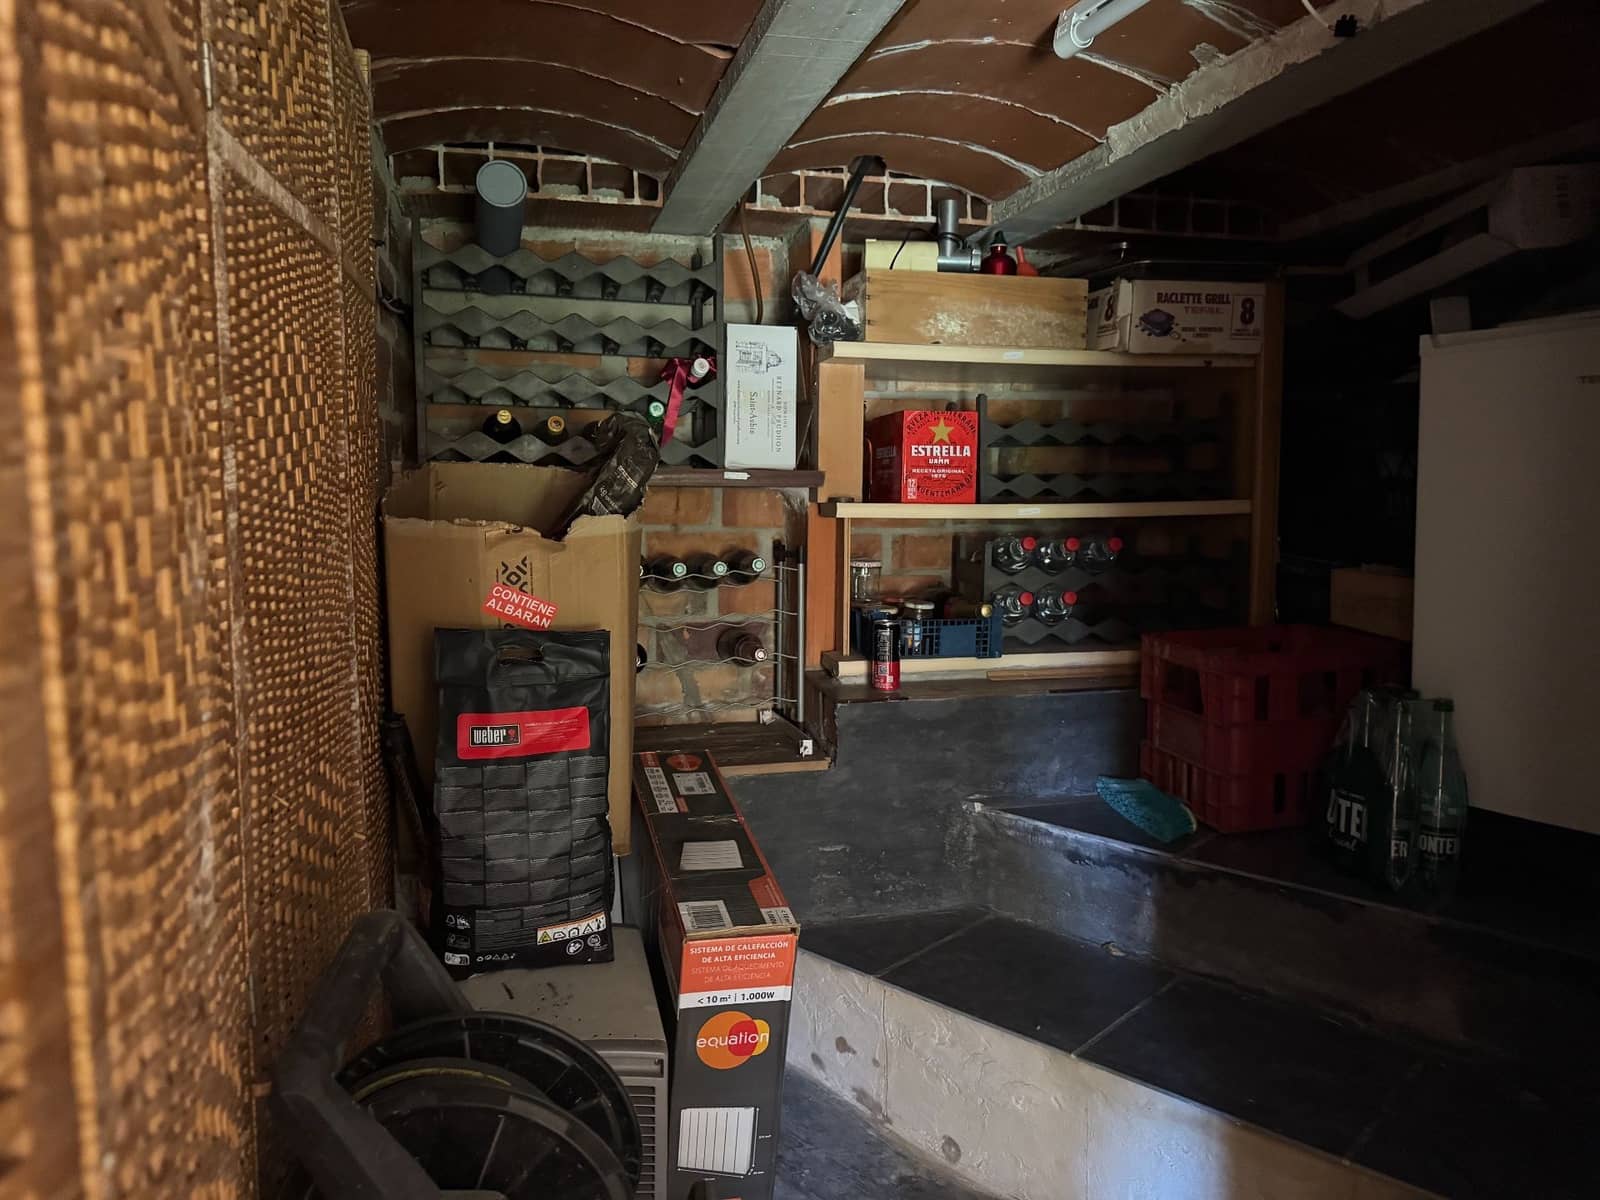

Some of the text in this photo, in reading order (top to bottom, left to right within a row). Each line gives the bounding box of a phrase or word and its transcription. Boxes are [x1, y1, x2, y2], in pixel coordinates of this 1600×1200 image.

[1156, 292, 1231, 305] RACLETTE GRILL
[1104, 295, 1114, 322] 8
[1240, 297, 1255, 325] 8
[911, 445, 971, 457] ESTRELLA
[492, 586, 557, 617] CONTIENE
[486, 598, 552, 629] ALBARAN
[473, 727, 507, 744] weber
[690, 940, 789, 955] SISTEMA DE CALEFACCIÓN
[713, 955, 733, 963] ALTA
[734, 952, 776, 961] EFICIENCIA
[707, 996, 718, 1004] 10
[741, 991, 775, 1001] 1.000W
[696, 1031, 769, 1048] equation
